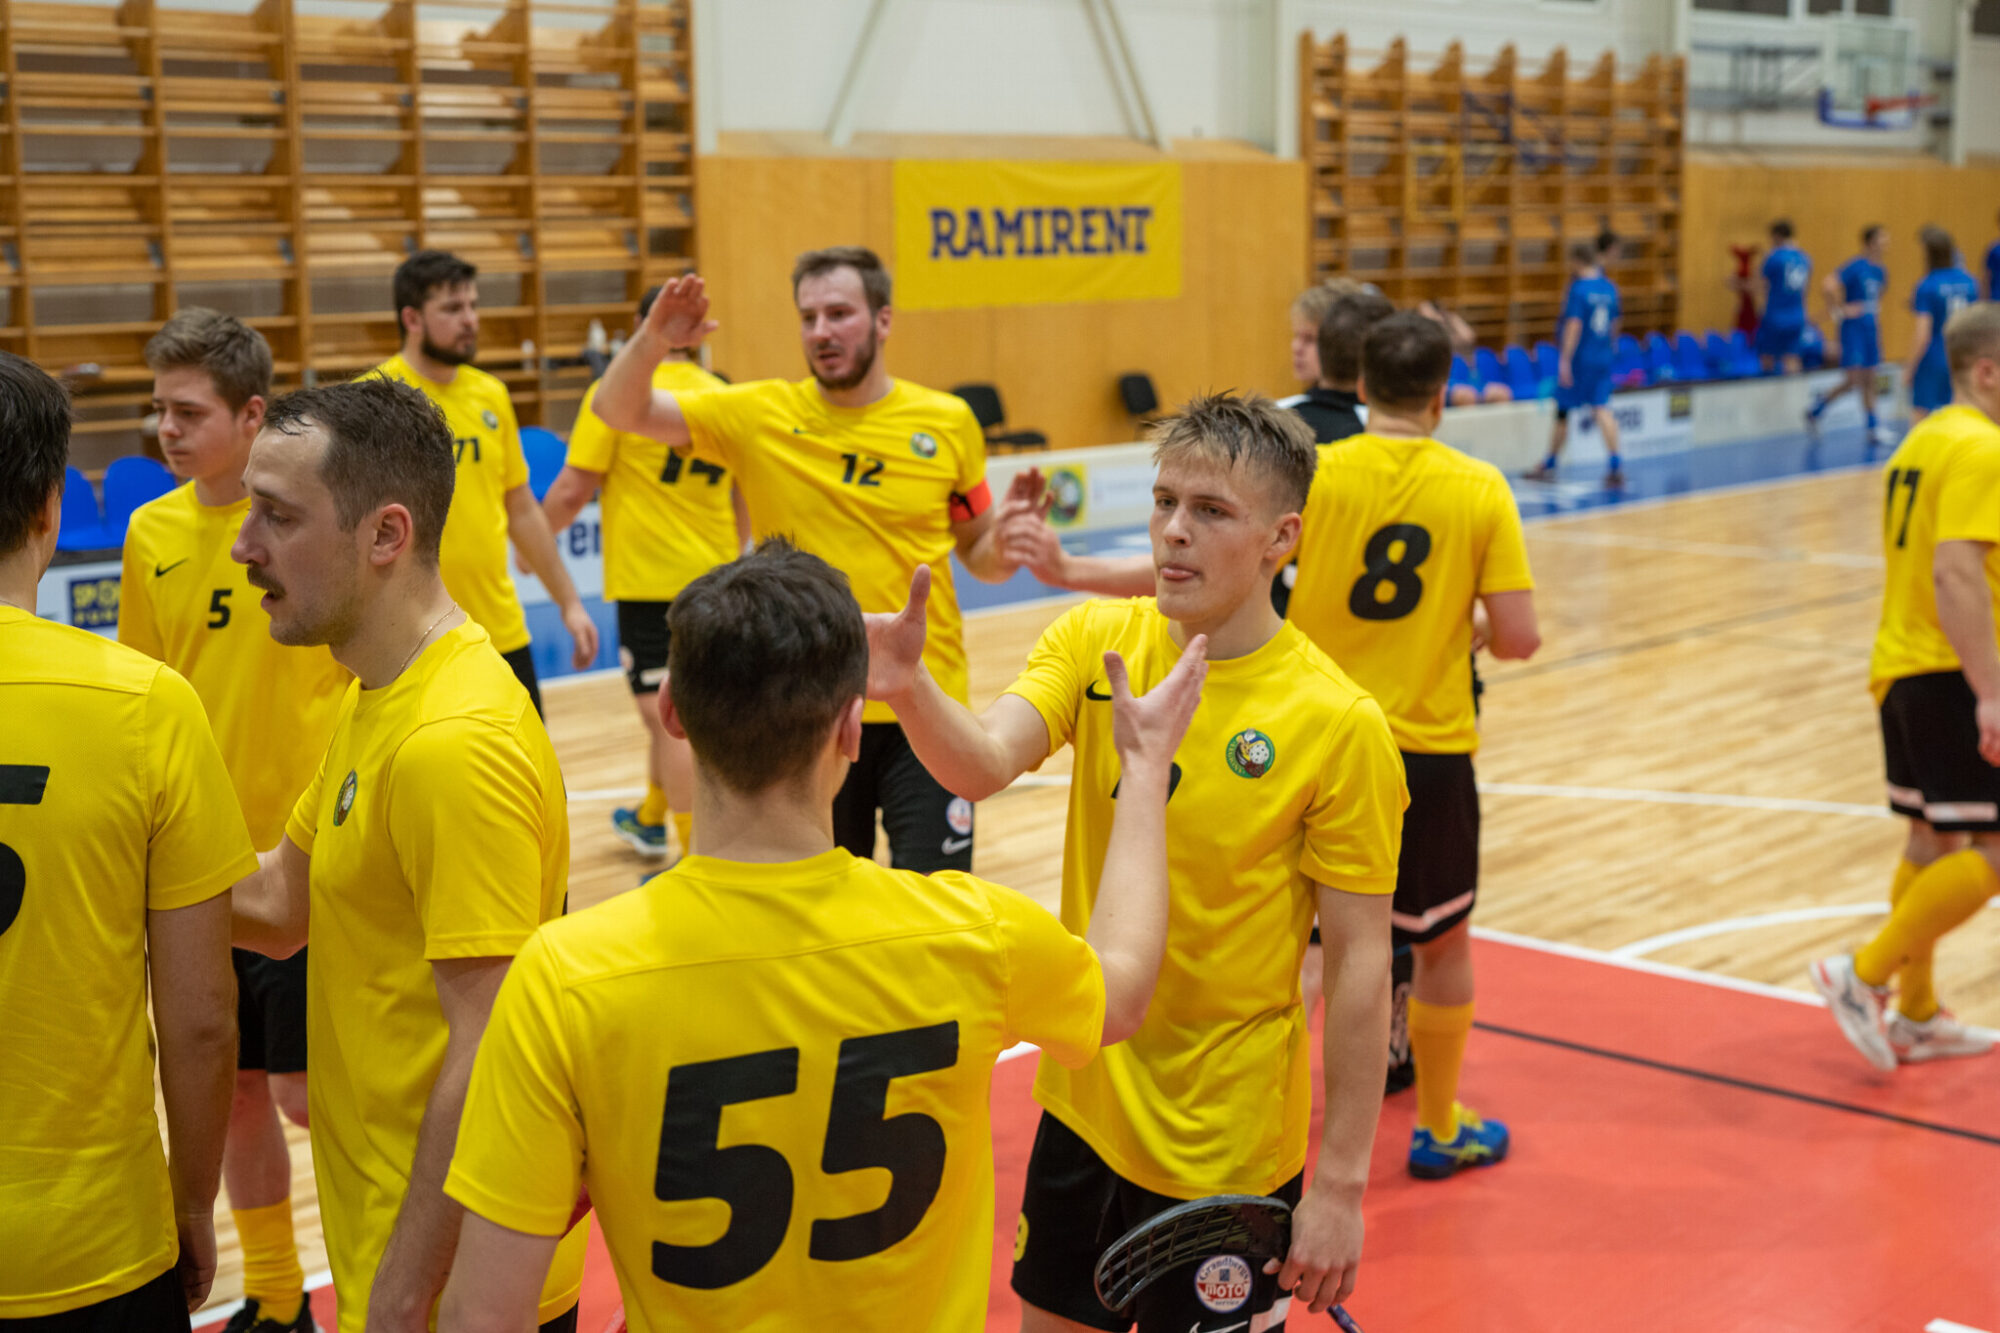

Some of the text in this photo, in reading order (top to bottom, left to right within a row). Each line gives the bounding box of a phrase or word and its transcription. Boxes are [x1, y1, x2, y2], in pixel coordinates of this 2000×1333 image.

[930, 206, 1154, 260] RAMIRENT
[453, 437, 480, 463] 71
[841, 452, 884, 487] 12
[1886, 467, 1921, 549] 17
[1348, 523, 1432, 621] 8
[207, 589, 232, 629] 5
[651, 1019, 960, 1291] 55
